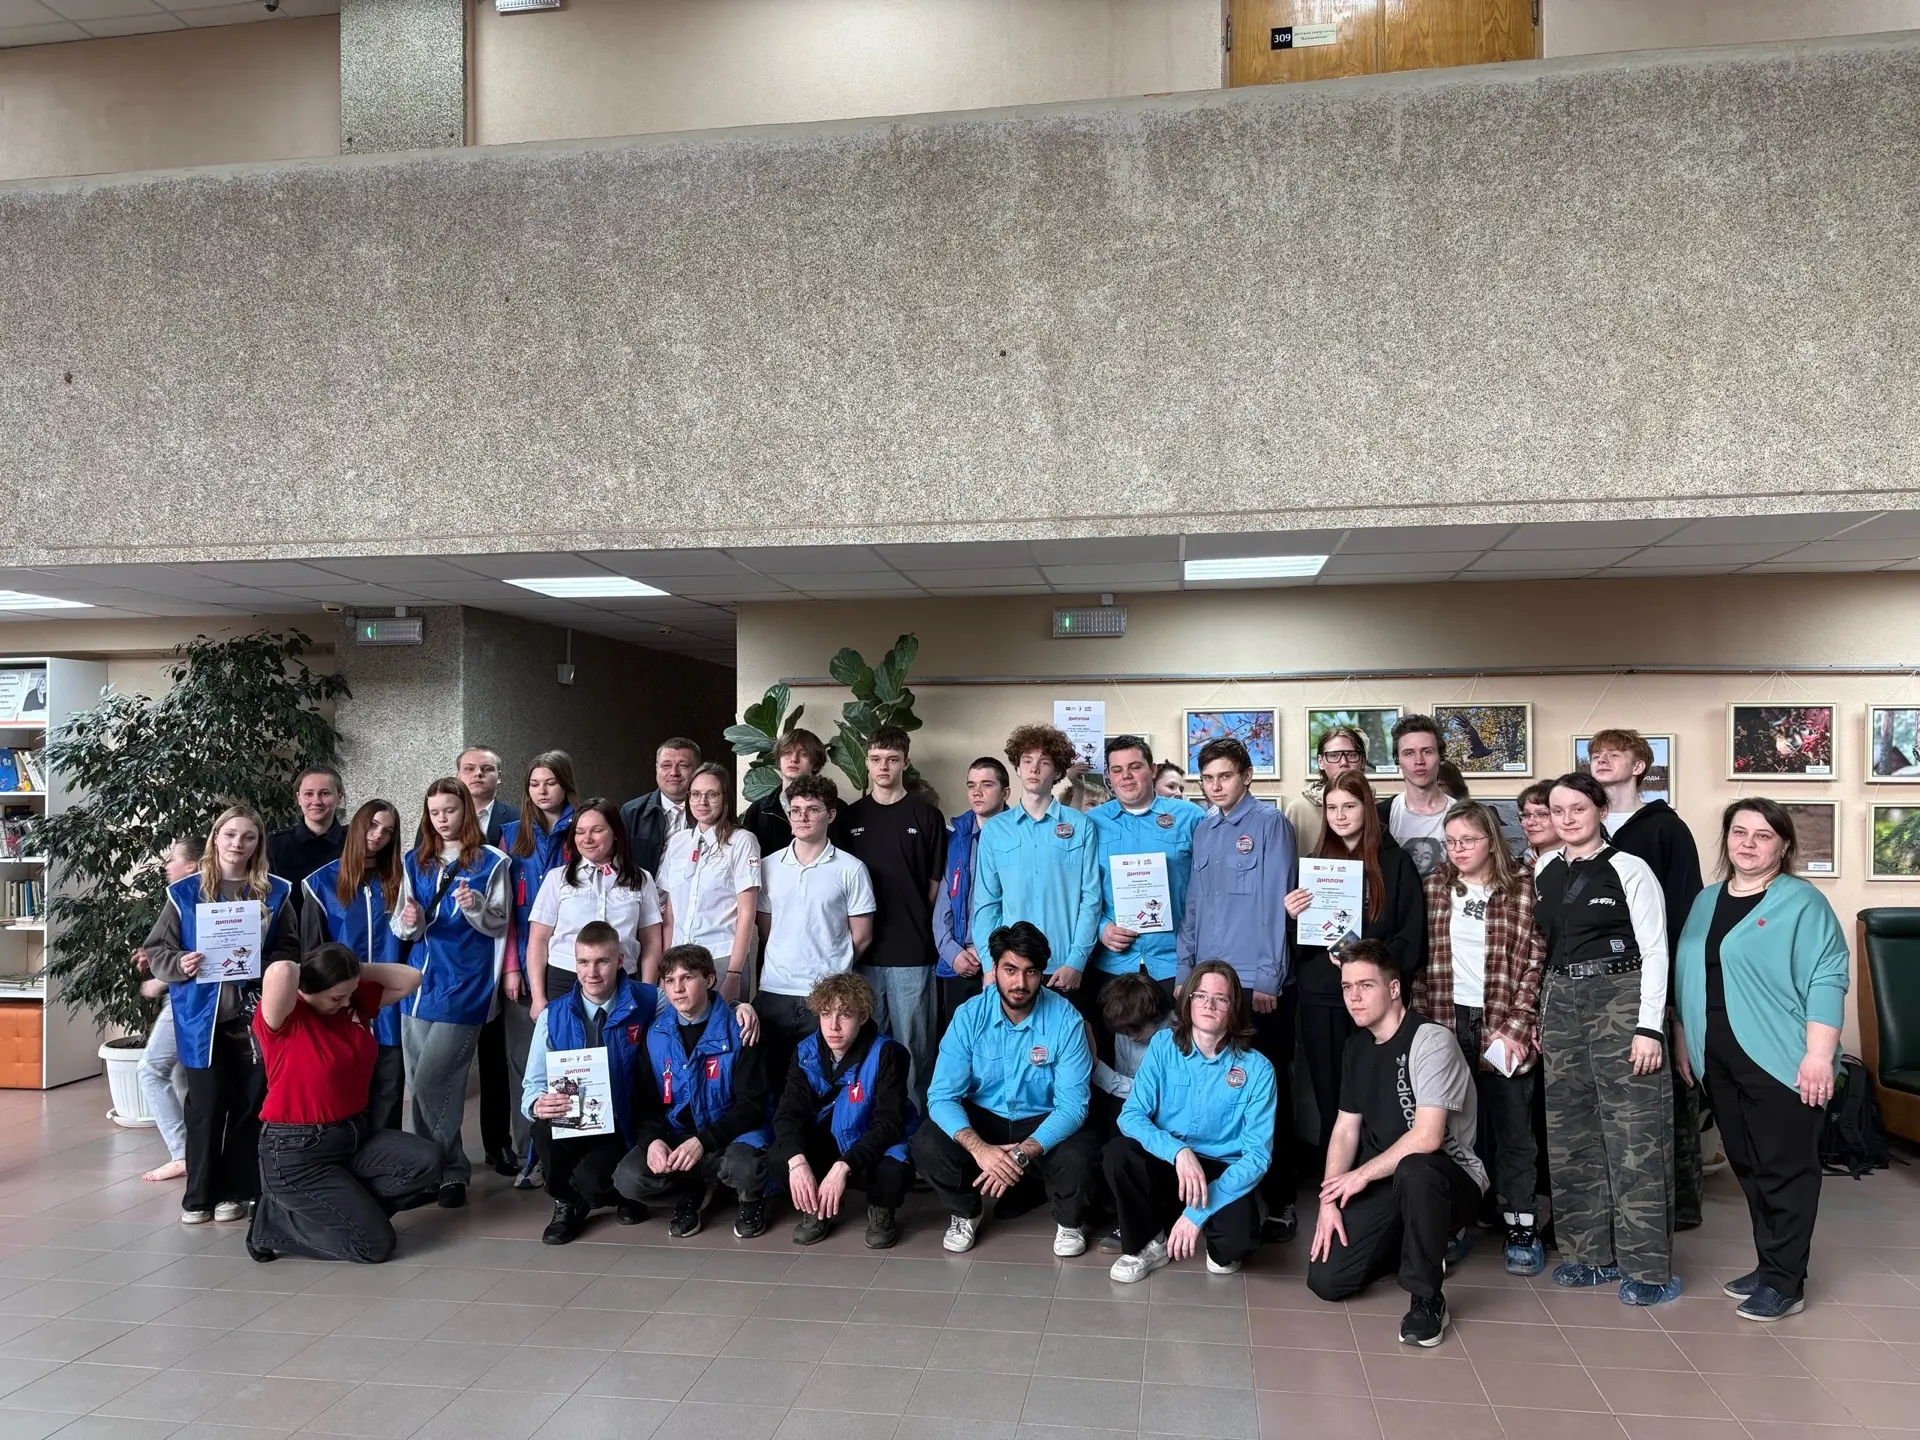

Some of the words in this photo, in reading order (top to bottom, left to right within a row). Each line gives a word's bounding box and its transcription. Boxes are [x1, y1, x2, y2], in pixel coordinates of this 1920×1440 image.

[1273, 33, 1291, 44] 309
[215, 918, 243, 926] ДИПЛОМ
[564, 1067, 591, 1075] ДИПЛОМ
